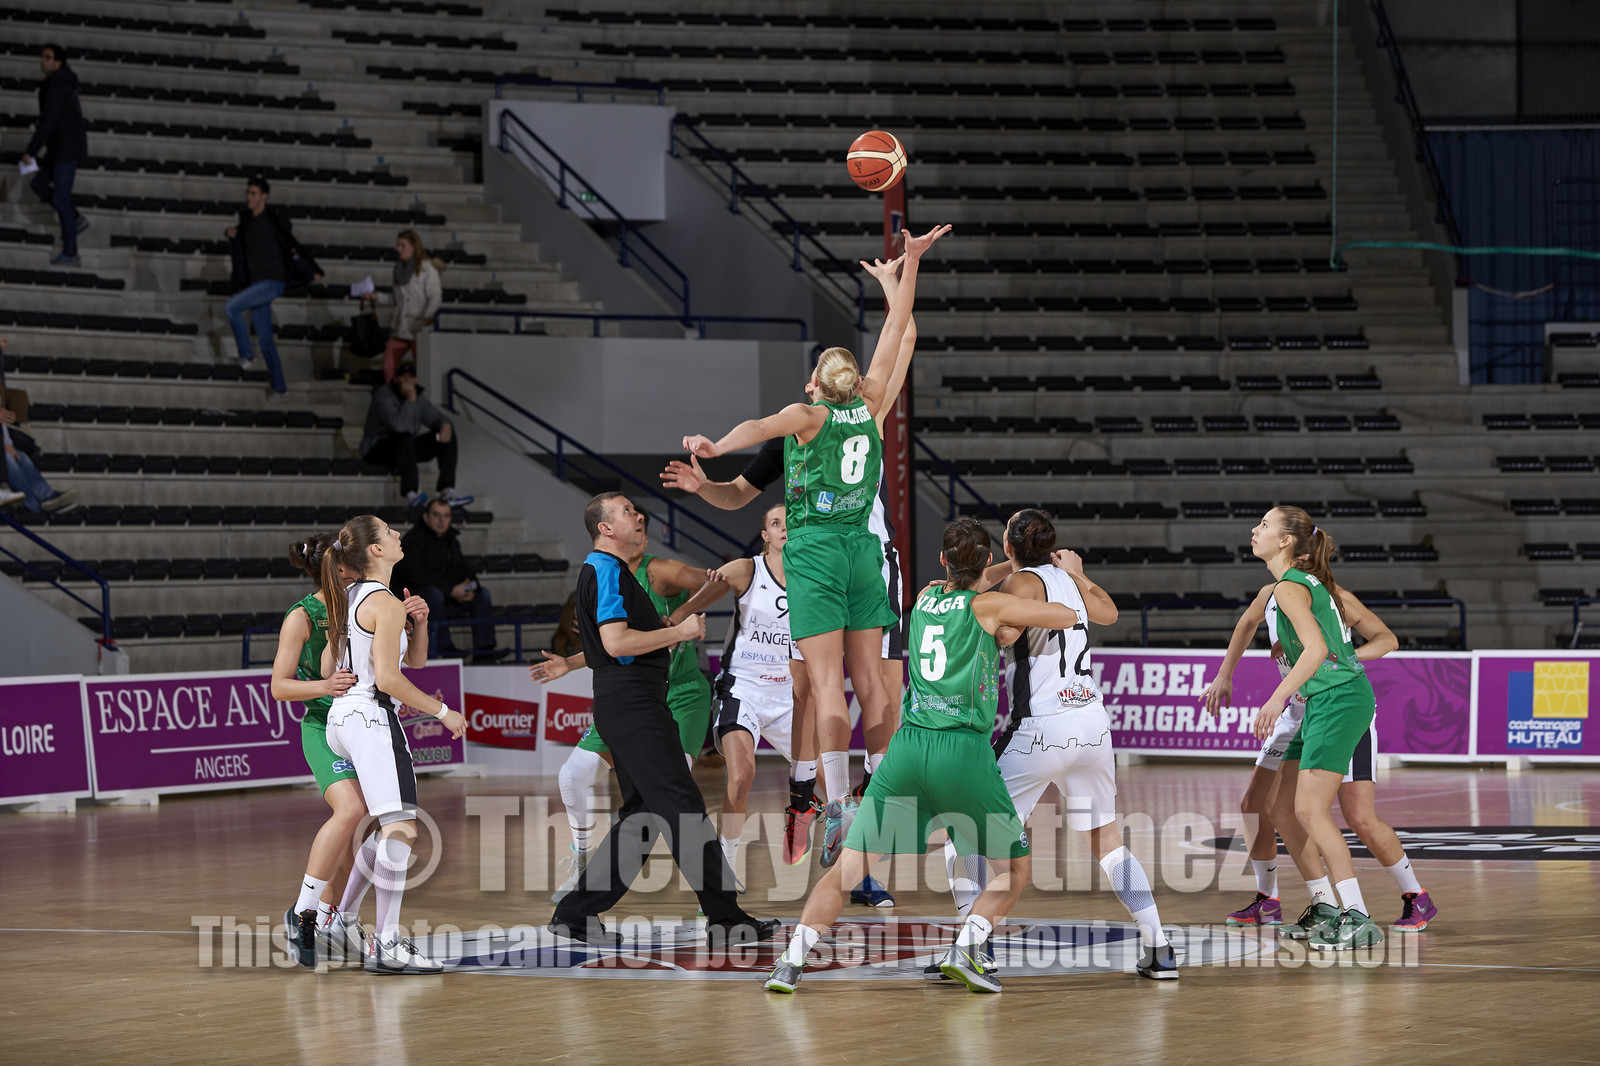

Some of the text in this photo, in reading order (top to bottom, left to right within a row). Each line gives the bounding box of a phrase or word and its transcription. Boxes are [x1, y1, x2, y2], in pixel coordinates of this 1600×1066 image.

[841, 434, 870, 484] 8
[775, 595, 789, 619] 9
[741, 650, 777, 663] ESPACE
[919, 624, 947, 682] 5
[1048, 622, 1091, 678] 12
[1092, 662, 1213, 697] LABEL
[95, 685, 217, 733] ESPACE
[471, 708, 535, 731] Courrier
[1, 723, 56, 756] LOIRE
[1508, 731, 1582, 744] HUTEAU
[194, 754, 251, 779] ANGERS
[412, 745, 452, 763] ANJOU
